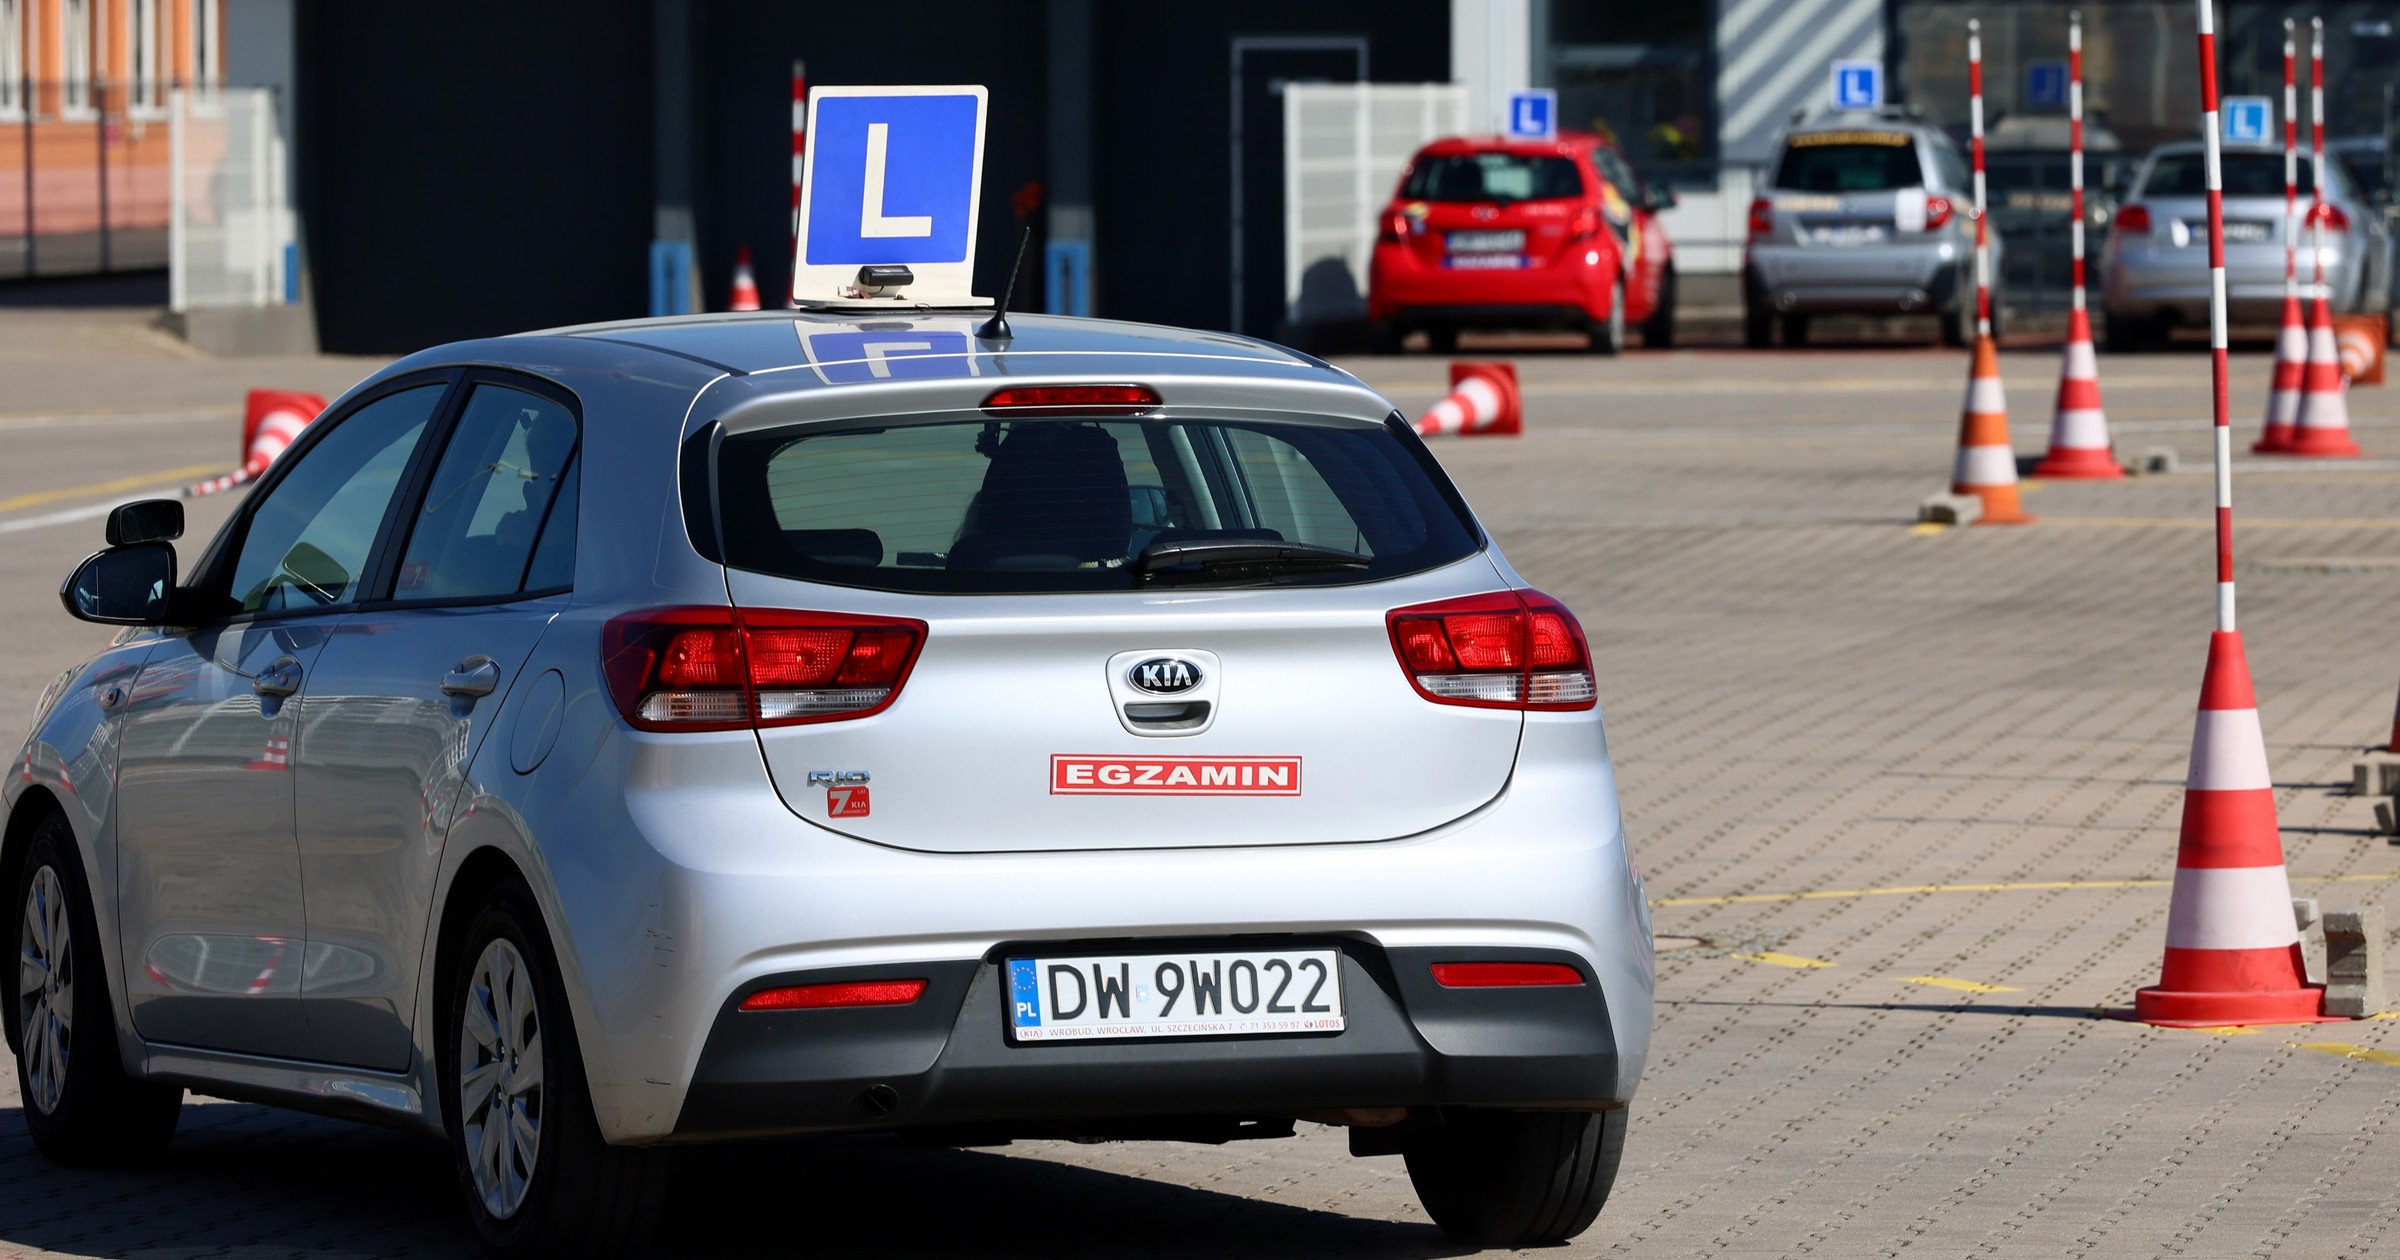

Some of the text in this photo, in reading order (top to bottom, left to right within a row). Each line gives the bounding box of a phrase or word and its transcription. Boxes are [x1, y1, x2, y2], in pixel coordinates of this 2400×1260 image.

[1846, 70, 1872, 105] L
[1519, 99, 1544, 133] L
[2234, 106, 2258, 139] L
[860, 122, 933, 238] L
[1141, 664, 1193, 688] KIA
[807, 770, 872, 788] RIO
[1065, 763, 1289, 787] EGZAMIN
[830, 790, 852, 815] 7
[851, 801, 867, 809] KIA
[1047, 958, 1331, 1021] DW 9W022
[1016, 1002, 1037, 1018] PL
[1050, 1027, 1094, 1037] WROBUD,
[1097, 1025, 1147, 1035] WROCŁAW,
[1151, 1024, 1165, 1033] UL.
[1167, 1021, 1226, 1033] SZCZECIŃSKA
[1250, 1022, 1259, 1030] 71
[1262, 1021, 1276, 1029] 353
[1279, 1021, 1288, 1029] 59
[1290, 1021, 1299, 1029] 97
[1314, 1018, 1341, 1029] LOTOS
